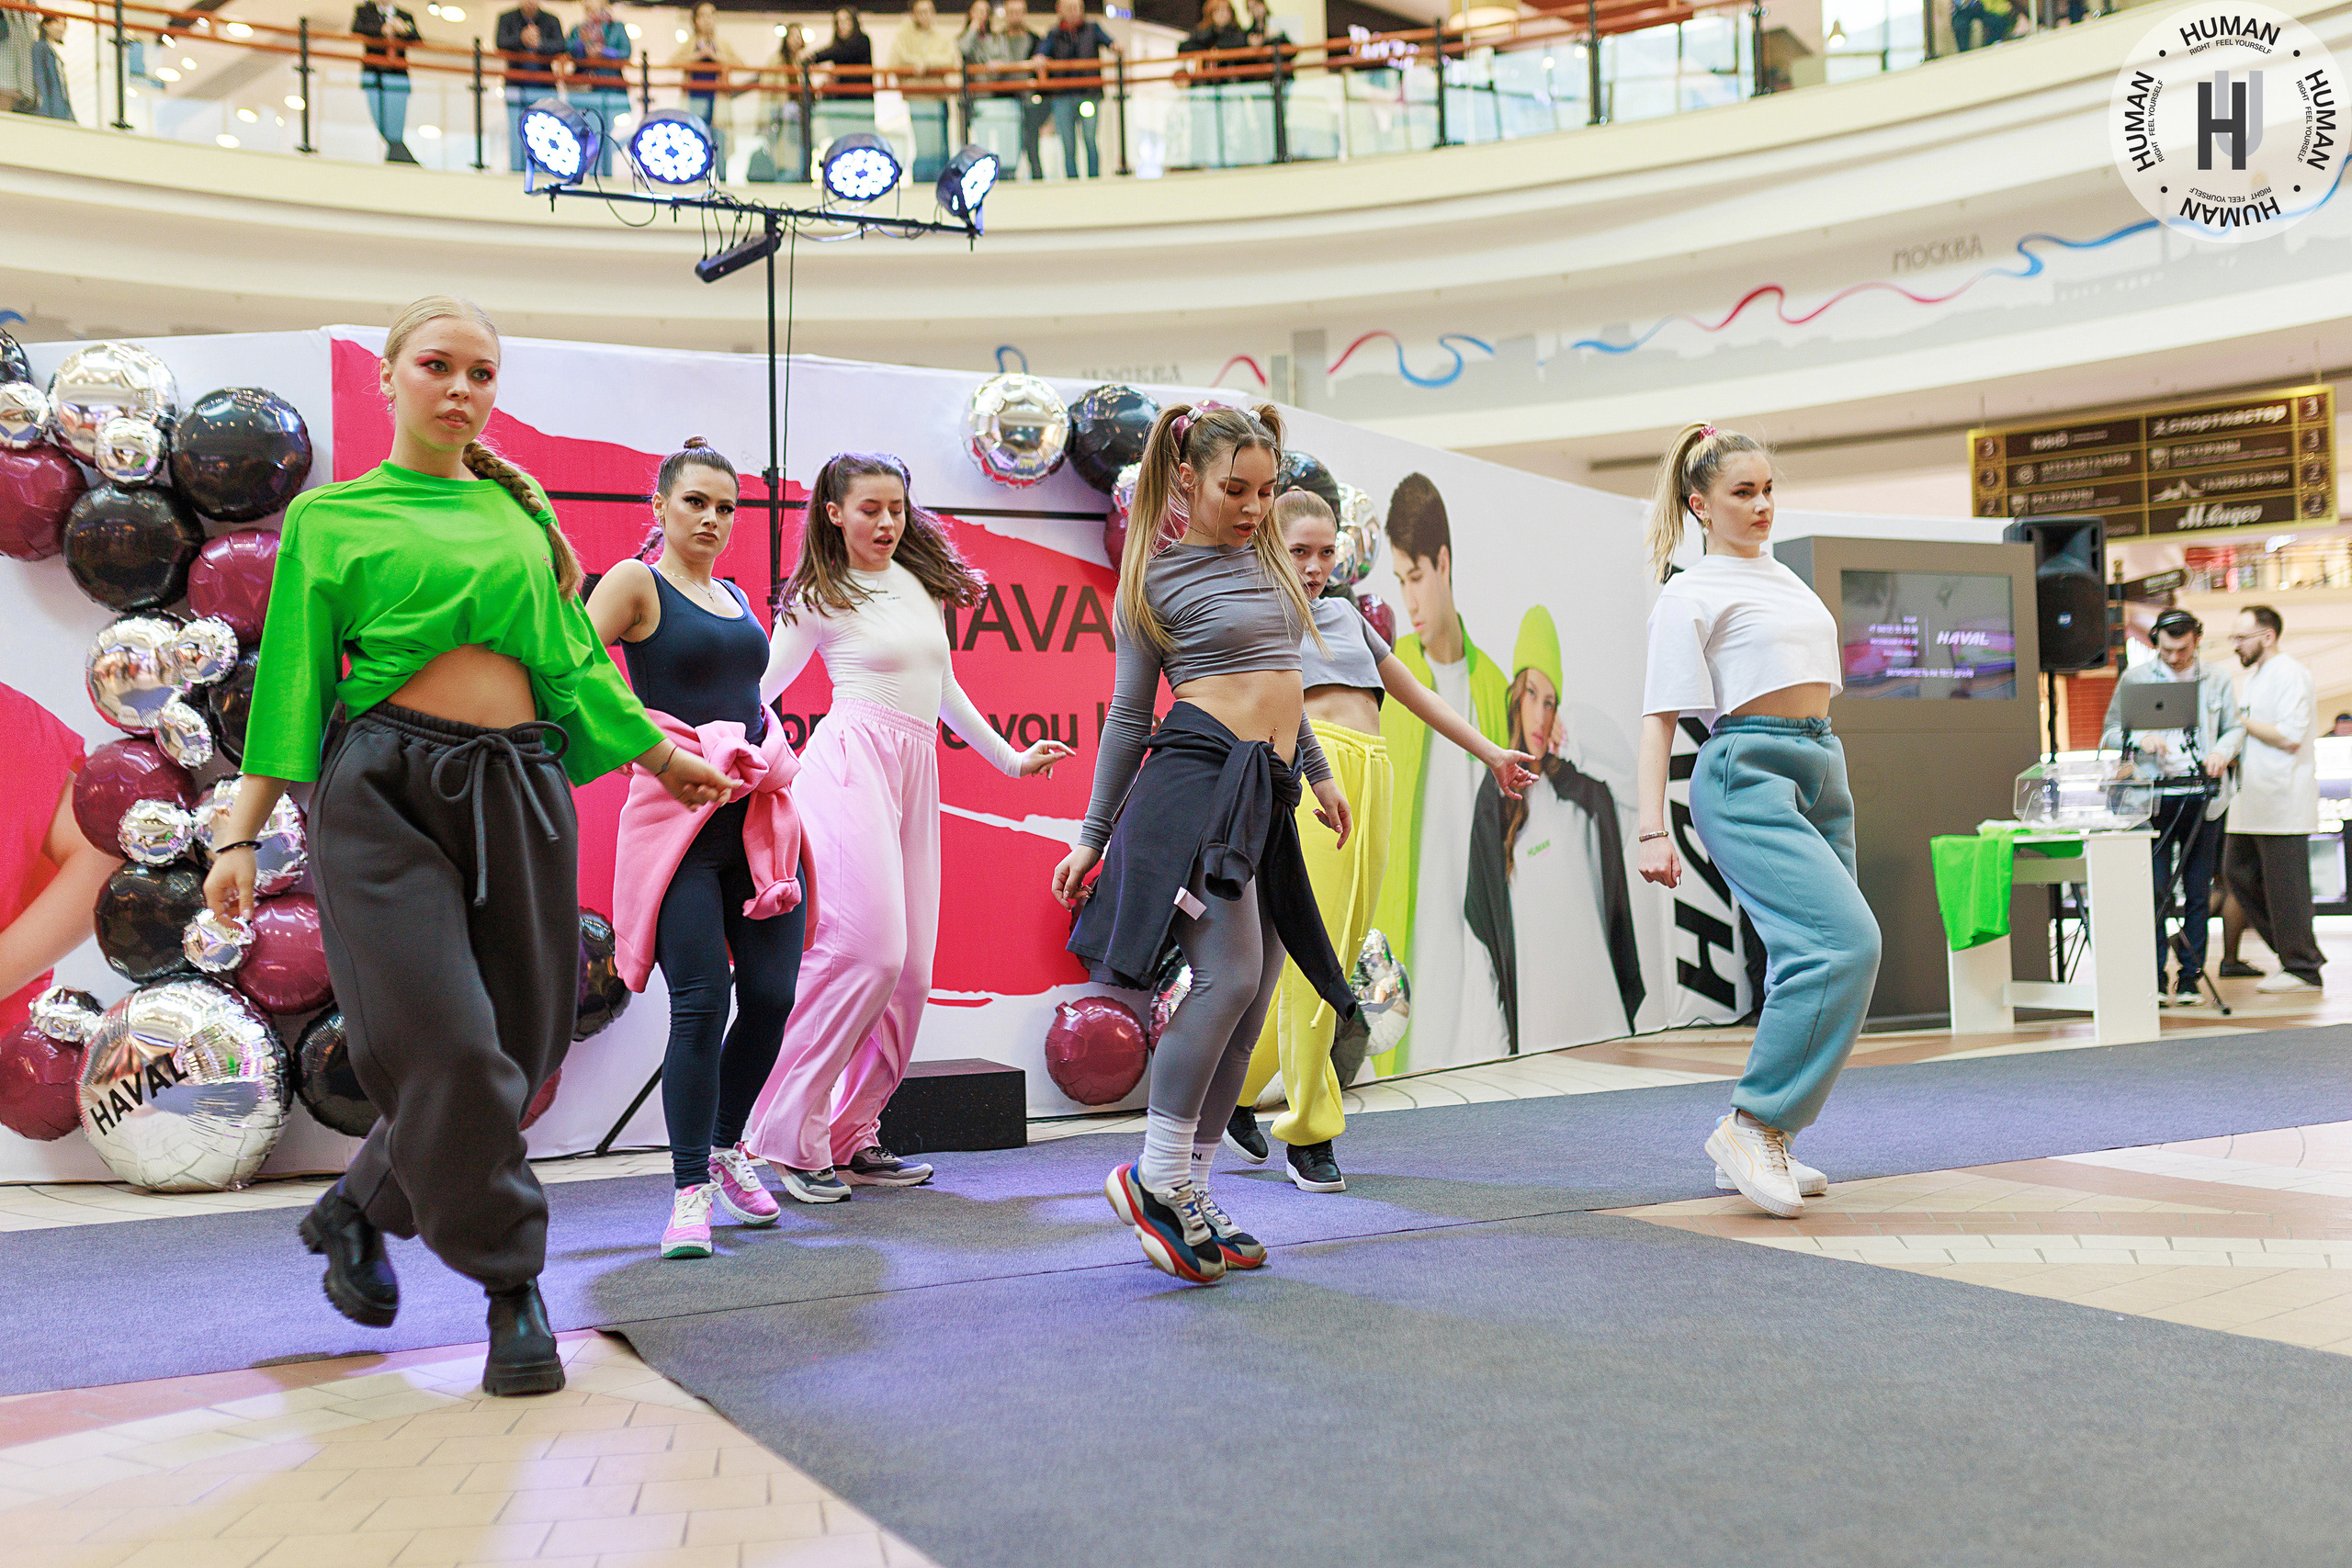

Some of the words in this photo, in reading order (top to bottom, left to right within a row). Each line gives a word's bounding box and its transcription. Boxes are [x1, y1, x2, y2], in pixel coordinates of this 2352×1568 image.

[1892, 234, 1984, 274] МОСКВА
[944, 584, 1116, 652] AVA
[1936, 630, 1989, 646] HAVAL
[90, 1052, 189, 1135] HAVAL
